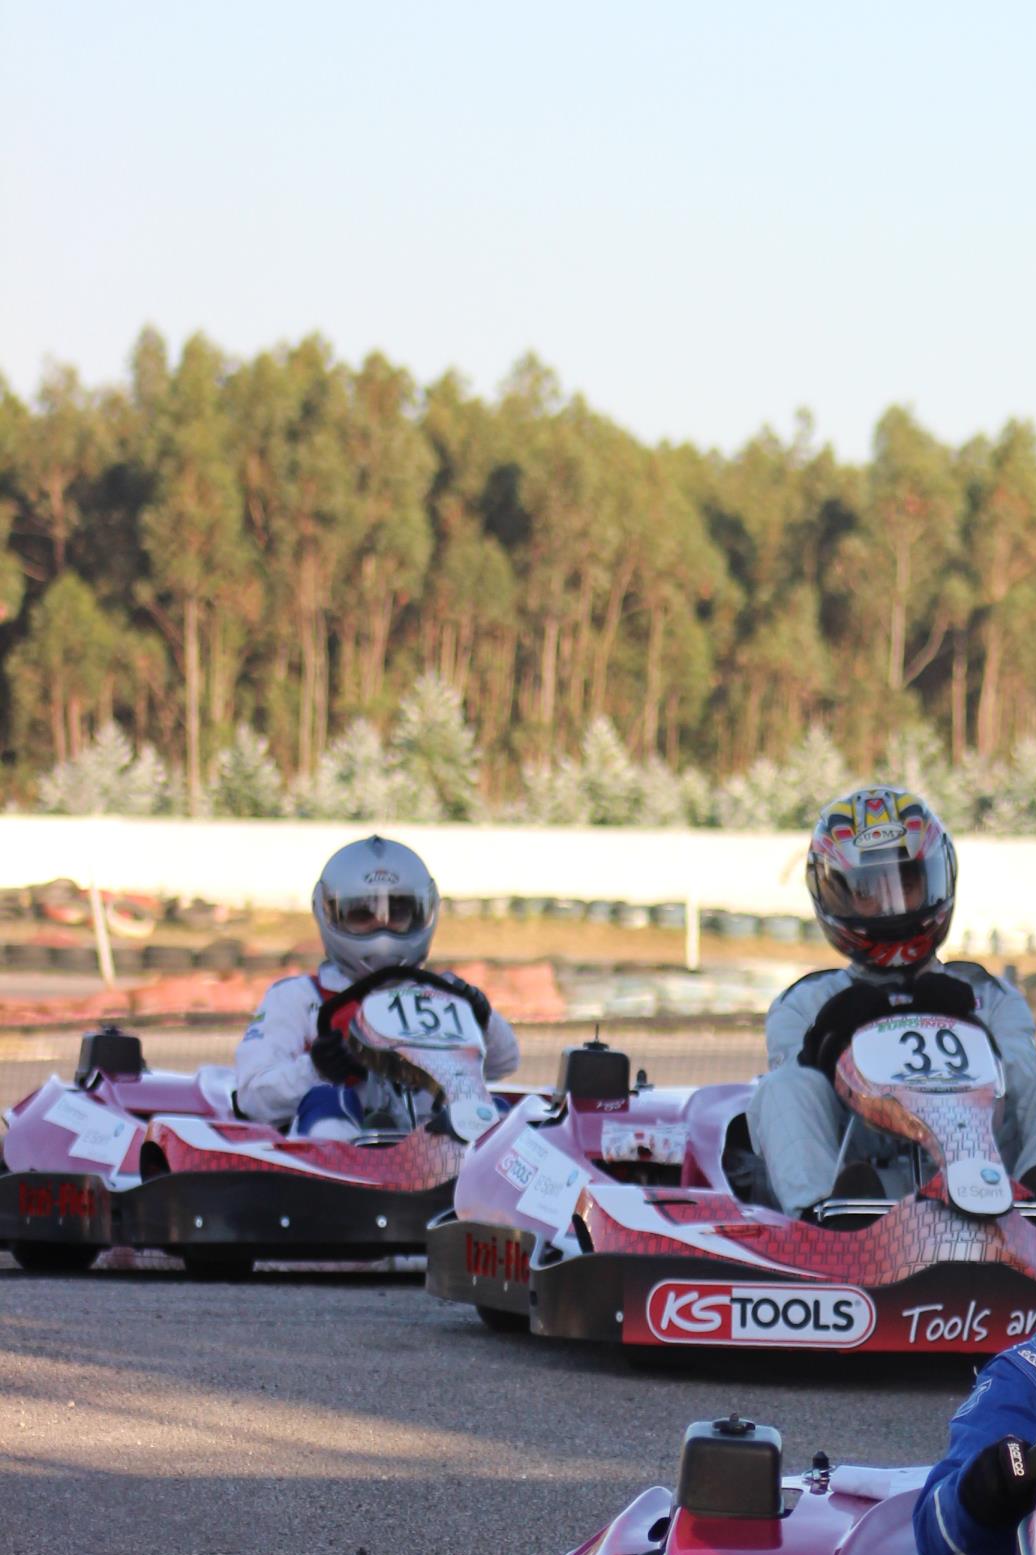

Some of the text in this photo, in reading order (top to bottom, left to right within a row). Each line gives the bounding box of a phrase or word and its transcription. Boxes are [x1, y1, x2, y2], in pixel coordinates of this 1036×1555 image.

[388, 993, 463, 1034] 151
[899, 1029, 968, 1072] 39
[731, 1297, 856, 1332] TOOLS
[902, 1301, 990, 1344] Tools
